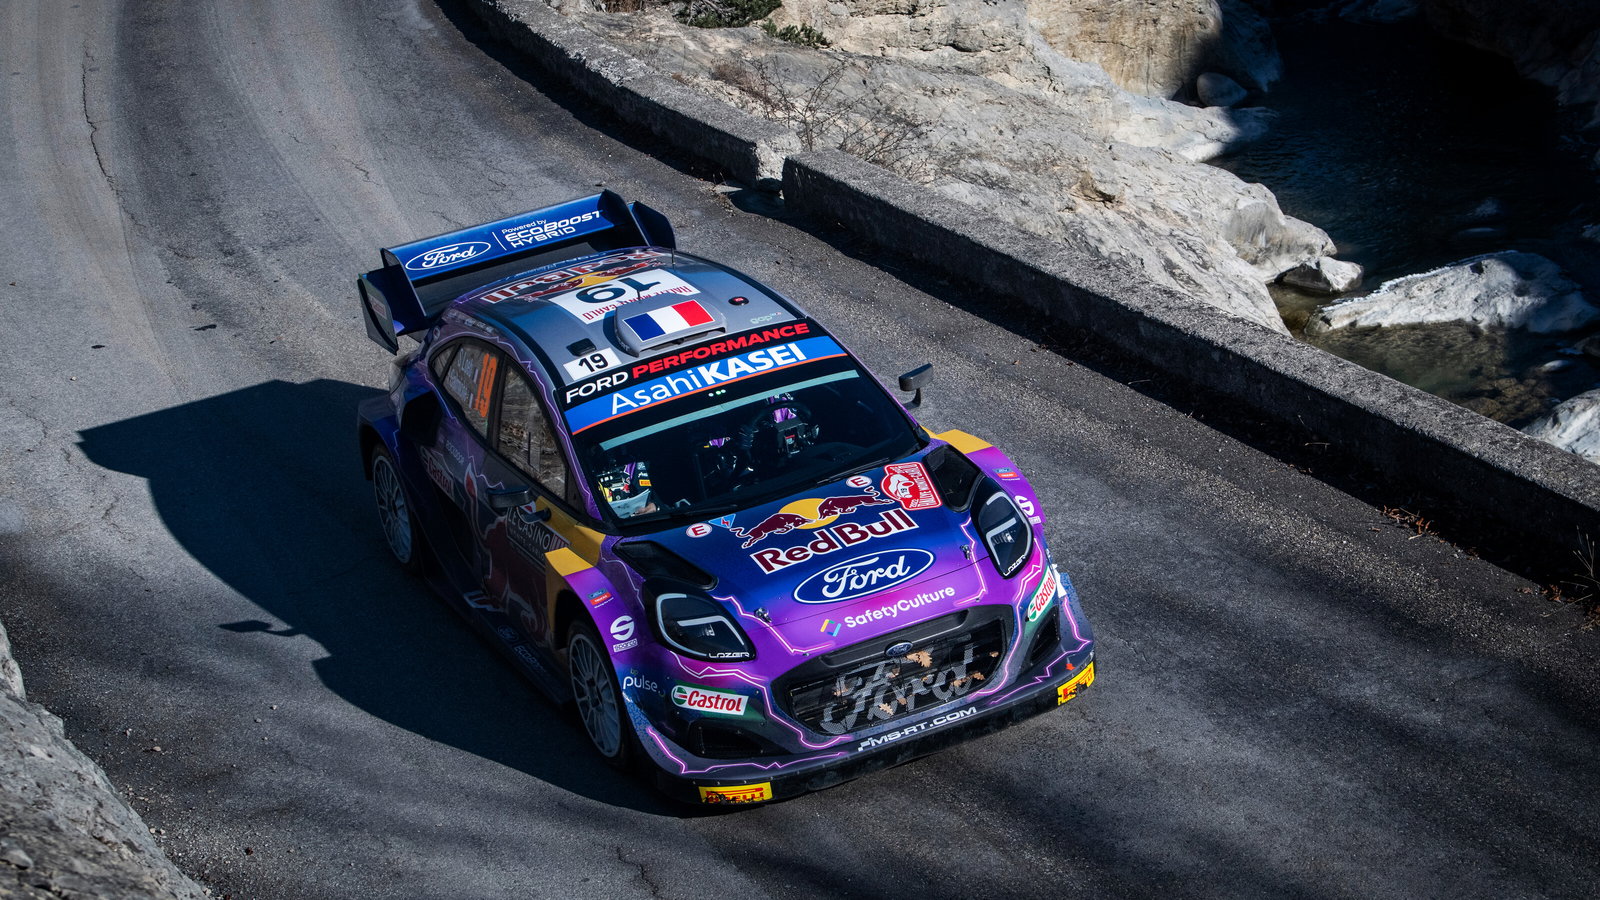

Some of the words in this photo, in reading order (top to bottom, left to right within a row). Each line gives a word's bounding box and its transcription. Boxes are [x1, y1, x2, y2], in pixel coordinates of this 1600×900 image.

[501, 221, 537, 234] Powered
[537, 219, 547, 227] by
[505, 210, 600, 242] ECOBOOST
[510, 226, 576, 248] HYBRID
[422, 245, 477, 268] Ford
[481, 270, 570, 304] Bull
[576, 276, 661, 304] 19
[565, 371, 628, 404] FORD
[633, 323, 810, 379] PERFORMANCE
[579, 352, 609, 374] 19
[750, 530, 842, 575] Red
[832, 507, 919, 547] Bull
[821, 555, 911, 599] Ford
[844, 586, 956, 628] SafetyCulture
[687, 690, 742, 712] Castrol
